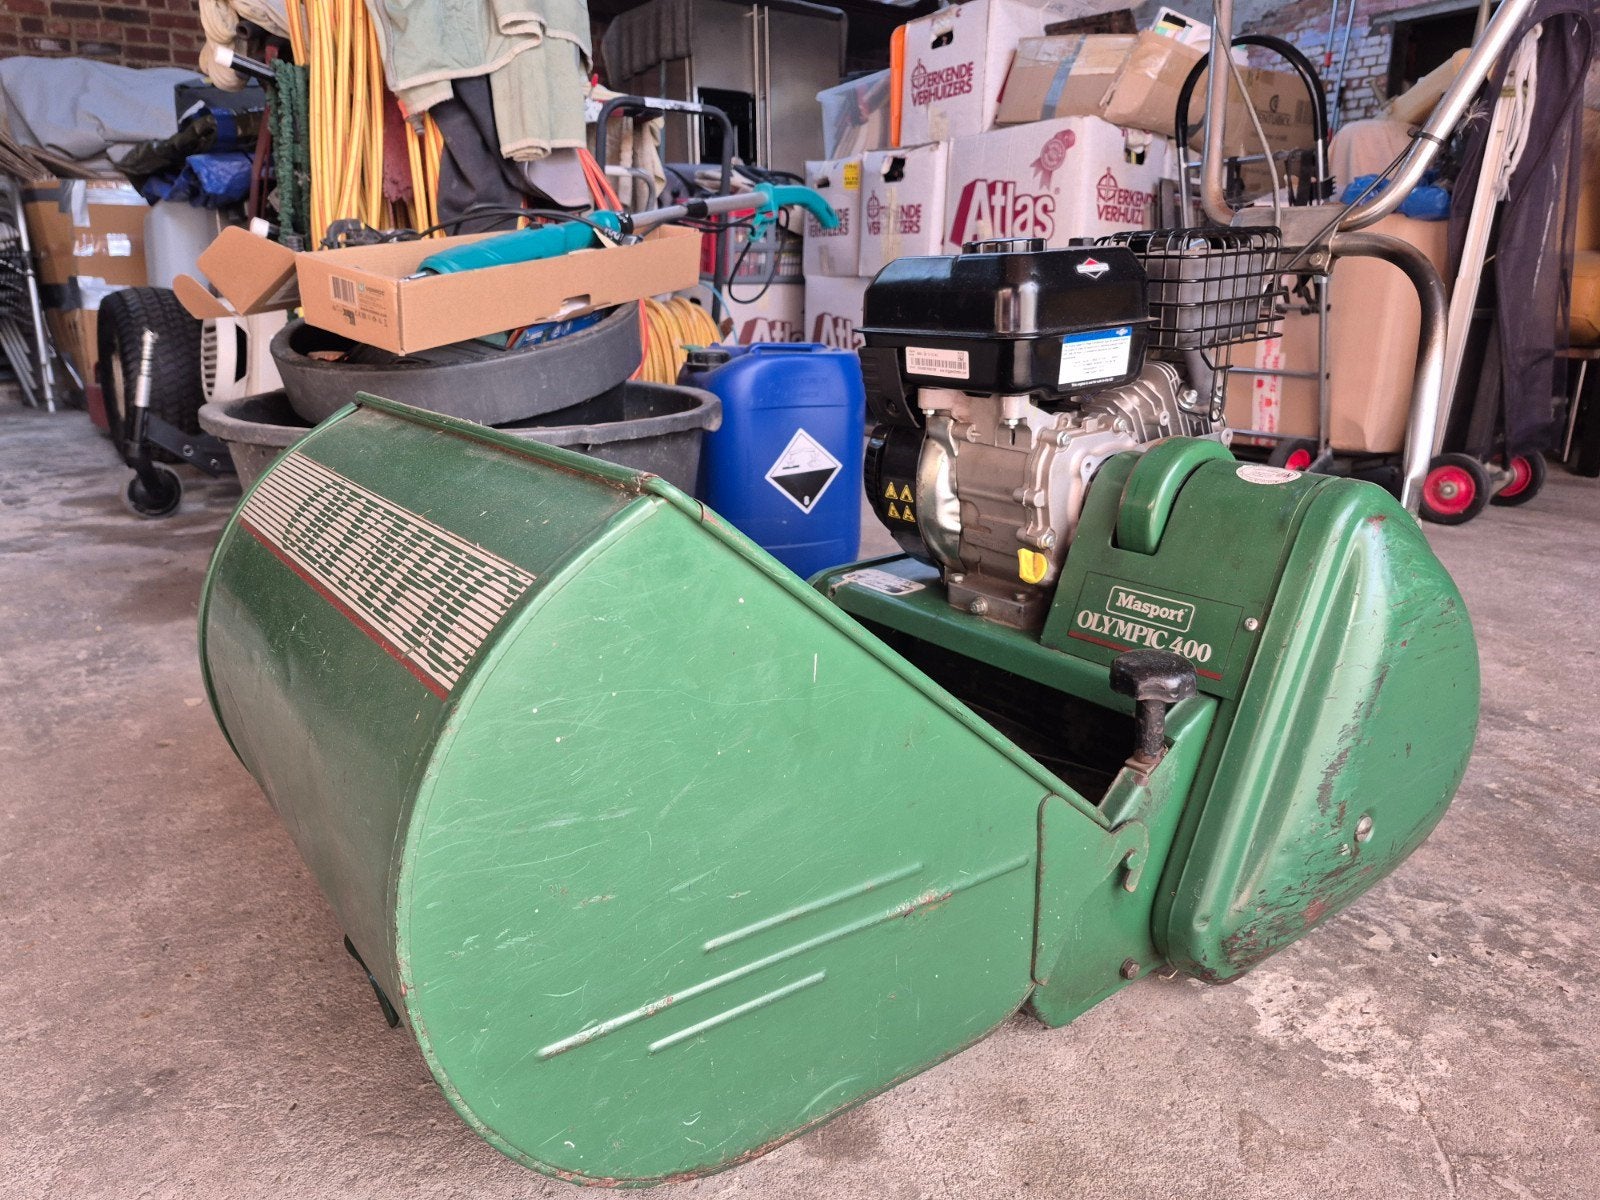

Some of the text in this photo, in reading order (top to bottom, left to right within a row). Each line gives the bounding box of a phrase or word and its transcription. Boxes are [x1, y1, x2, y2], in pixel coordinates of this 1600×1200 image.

[926, 61, 974, 87] ERKENDE
[911, 78, 973, 107] VERHUIZERS
[950, 178, 1056, 247] Atlas
[1116, 591, 1186, 623] Masport
[1077, 610, 1212, 663] OLYMPIC 400
